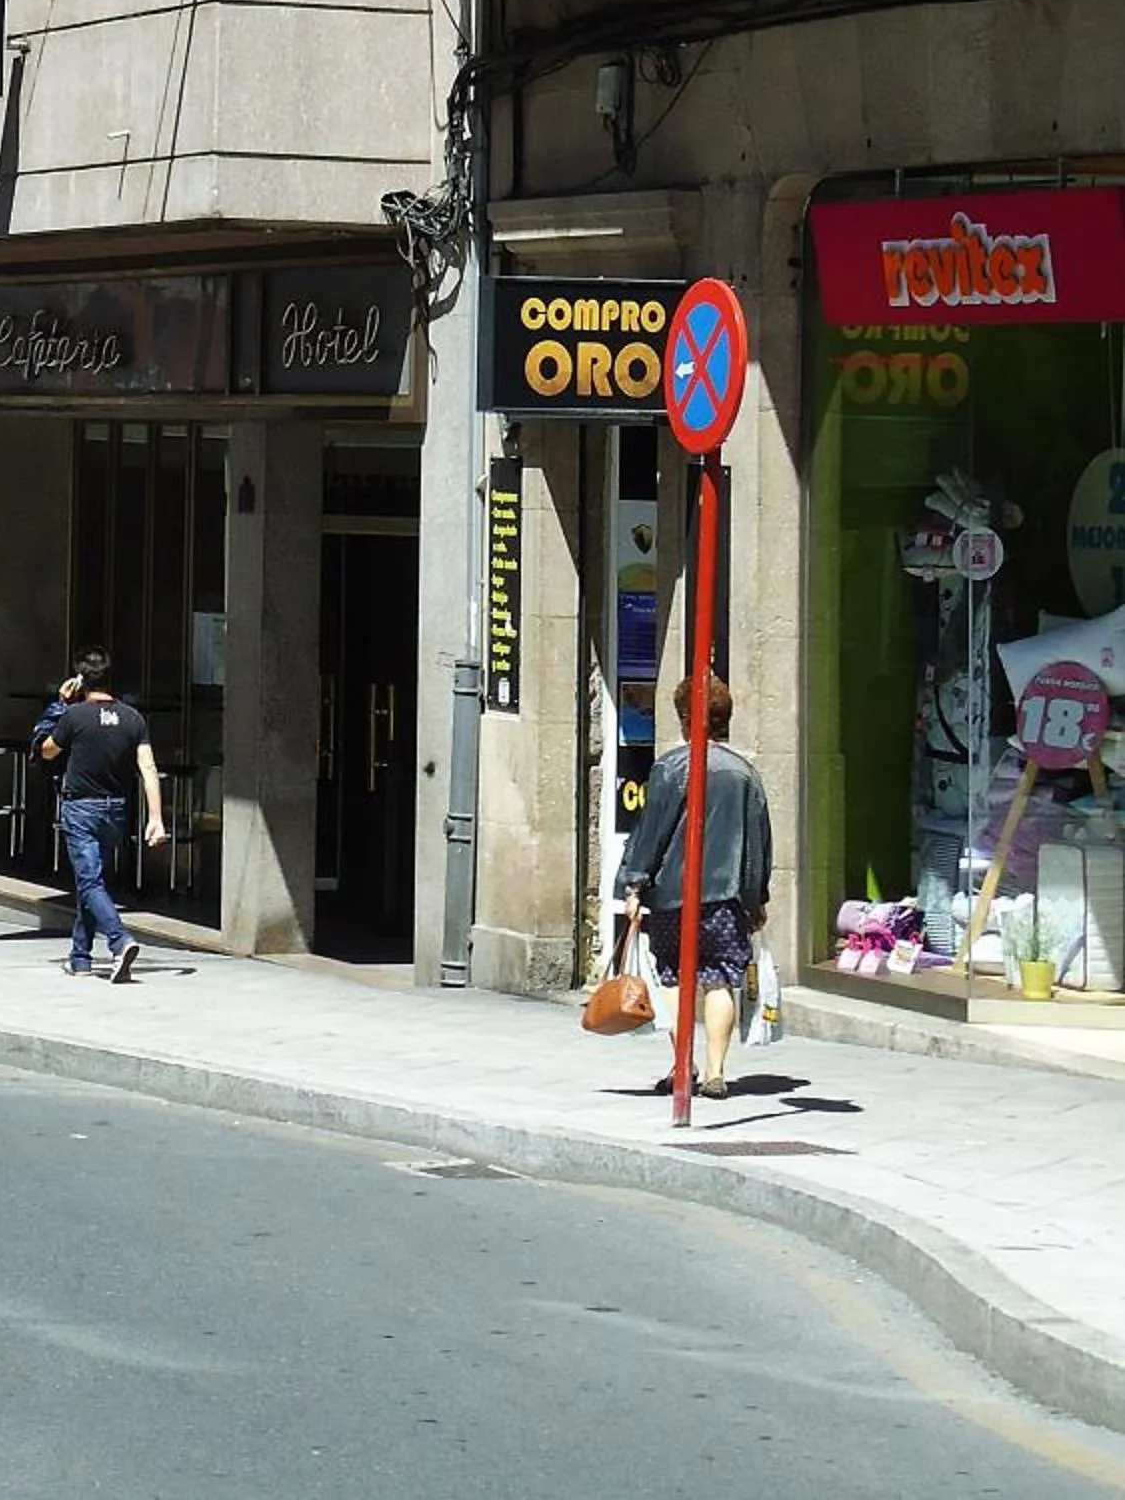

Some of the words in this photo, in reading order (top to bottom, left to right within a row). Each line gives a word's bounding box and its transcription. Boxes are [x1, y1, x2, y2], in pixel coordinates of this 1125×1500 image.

[882, 212, 1056, 307] revitex
[282, 302, 380, 369] Hotel
[520, 297, 666, 333] COMPRO
[524, 339, 662, 398] ORO
